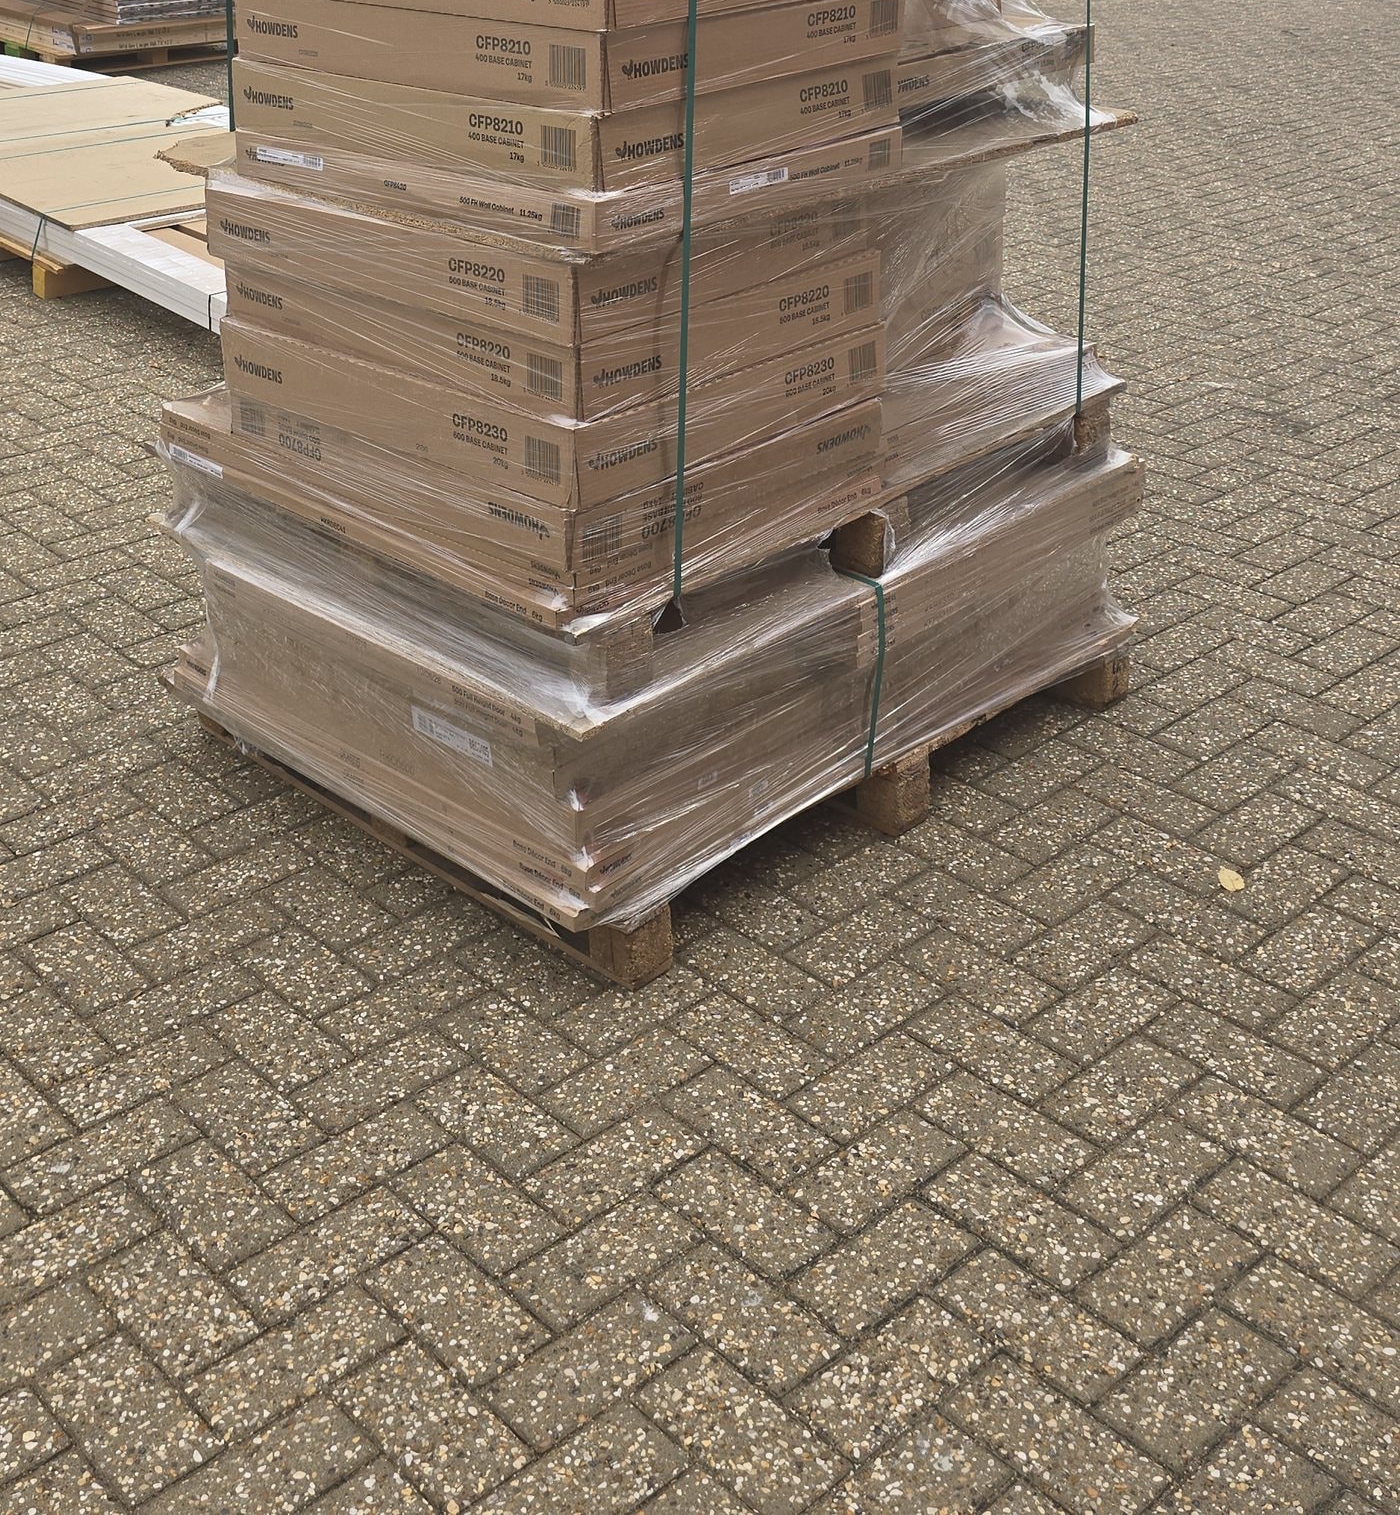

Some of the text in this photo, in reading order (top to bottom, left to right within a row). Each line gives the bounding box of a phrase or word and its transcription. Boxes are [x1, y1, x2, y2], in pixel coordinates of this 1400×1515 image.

[807, 5, 856, 27] CFP8210
[255, 20, 298, 38] HOWDENS
[807, 21, 856, 39] 400 BASE CABINET
[476, 34, 531, 56] CFP8210
[476, 53, 532, 69] 400 BASE CABINET
[633, 53, 689, 78] HOWDENS
[517, 72, 532, 83] 17kg
[251, 92, 294, 111] HOWDENS
[800, 79, 848, 102] CFP8210
[800, 96, 850, 115] 400 BASE CABINET
[469, 113, 523, 135] CFP8210
[468, 132, 524, 149] 400 BASE CABINET
[627, 133, 684, 160] HOWDENS
[509, 151, 524, 163] 17kg
[459, 196, 542, 222] 500 FH Wall Cabinet 11.25kg
[620, 208, 664, 230] HOWDENS
[228, 223, 270, 244] HOWDENS
[449, 257, 505, 283] CFP8220
[449, 276, 505, 296] 500 BASE CABINET
[602, 277, 657, 307] HOWDENS
[243, 288, 283, 310] HOWDENS
[779, 285, 829, 312] CFP8220
[780, 301, 830, 324] 500 BASE CABINET
[456, 333, 510, 359] CFP8220
[243, 361, 282, 385] HOWDENS
[605, 354, 662, 385] HOWDENS
[785, 357, 834, 385] CFP8230
[453, 413, 508, 442] CFP8230
[466, 434, 481, 447] BASE
[482, 440, 508, 456] CABINET
[816, 428, 864, 454] HOWDENS
[602, 439, 657, 470] HOWDENS
[488, 501, 544, 533] HOWDENS
[464, 689, 475, 701] Full
[542, 853, 556, 867] End
